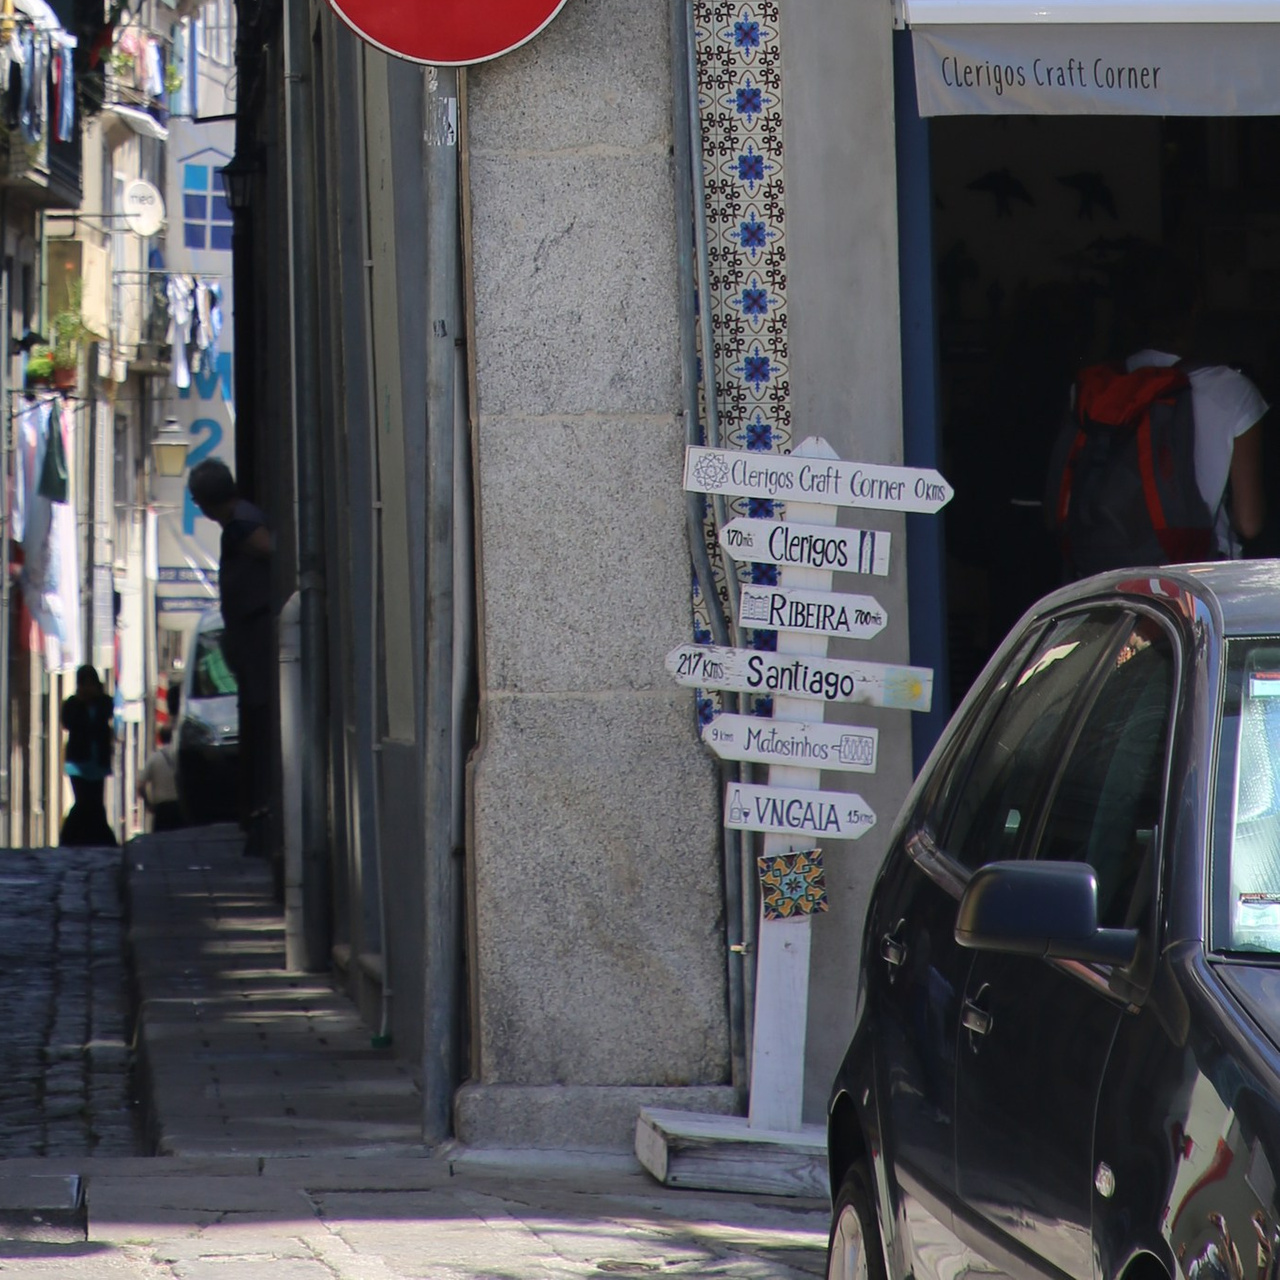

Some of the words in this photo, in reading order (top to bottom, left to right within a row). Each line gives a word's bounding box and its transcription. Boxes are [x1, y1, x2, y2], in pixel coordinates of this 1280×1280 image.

[941, 56, 1026, 96] Clerigos
[1033, 58, 1088, 88] Craft
[1093, 58, 1162, 89] Corner
[731, 459, 794, 495] Clerigos
[799, 464, 843, 495] Craft
[850, 469, 906, 502] Corner
[769, 526, 848, 567] Clerigos
[767, 593, 851, 632] RIBEIRA
[747, 655, 854, 700] Santiago
[743, 726, 829, 760] Matosinhos
